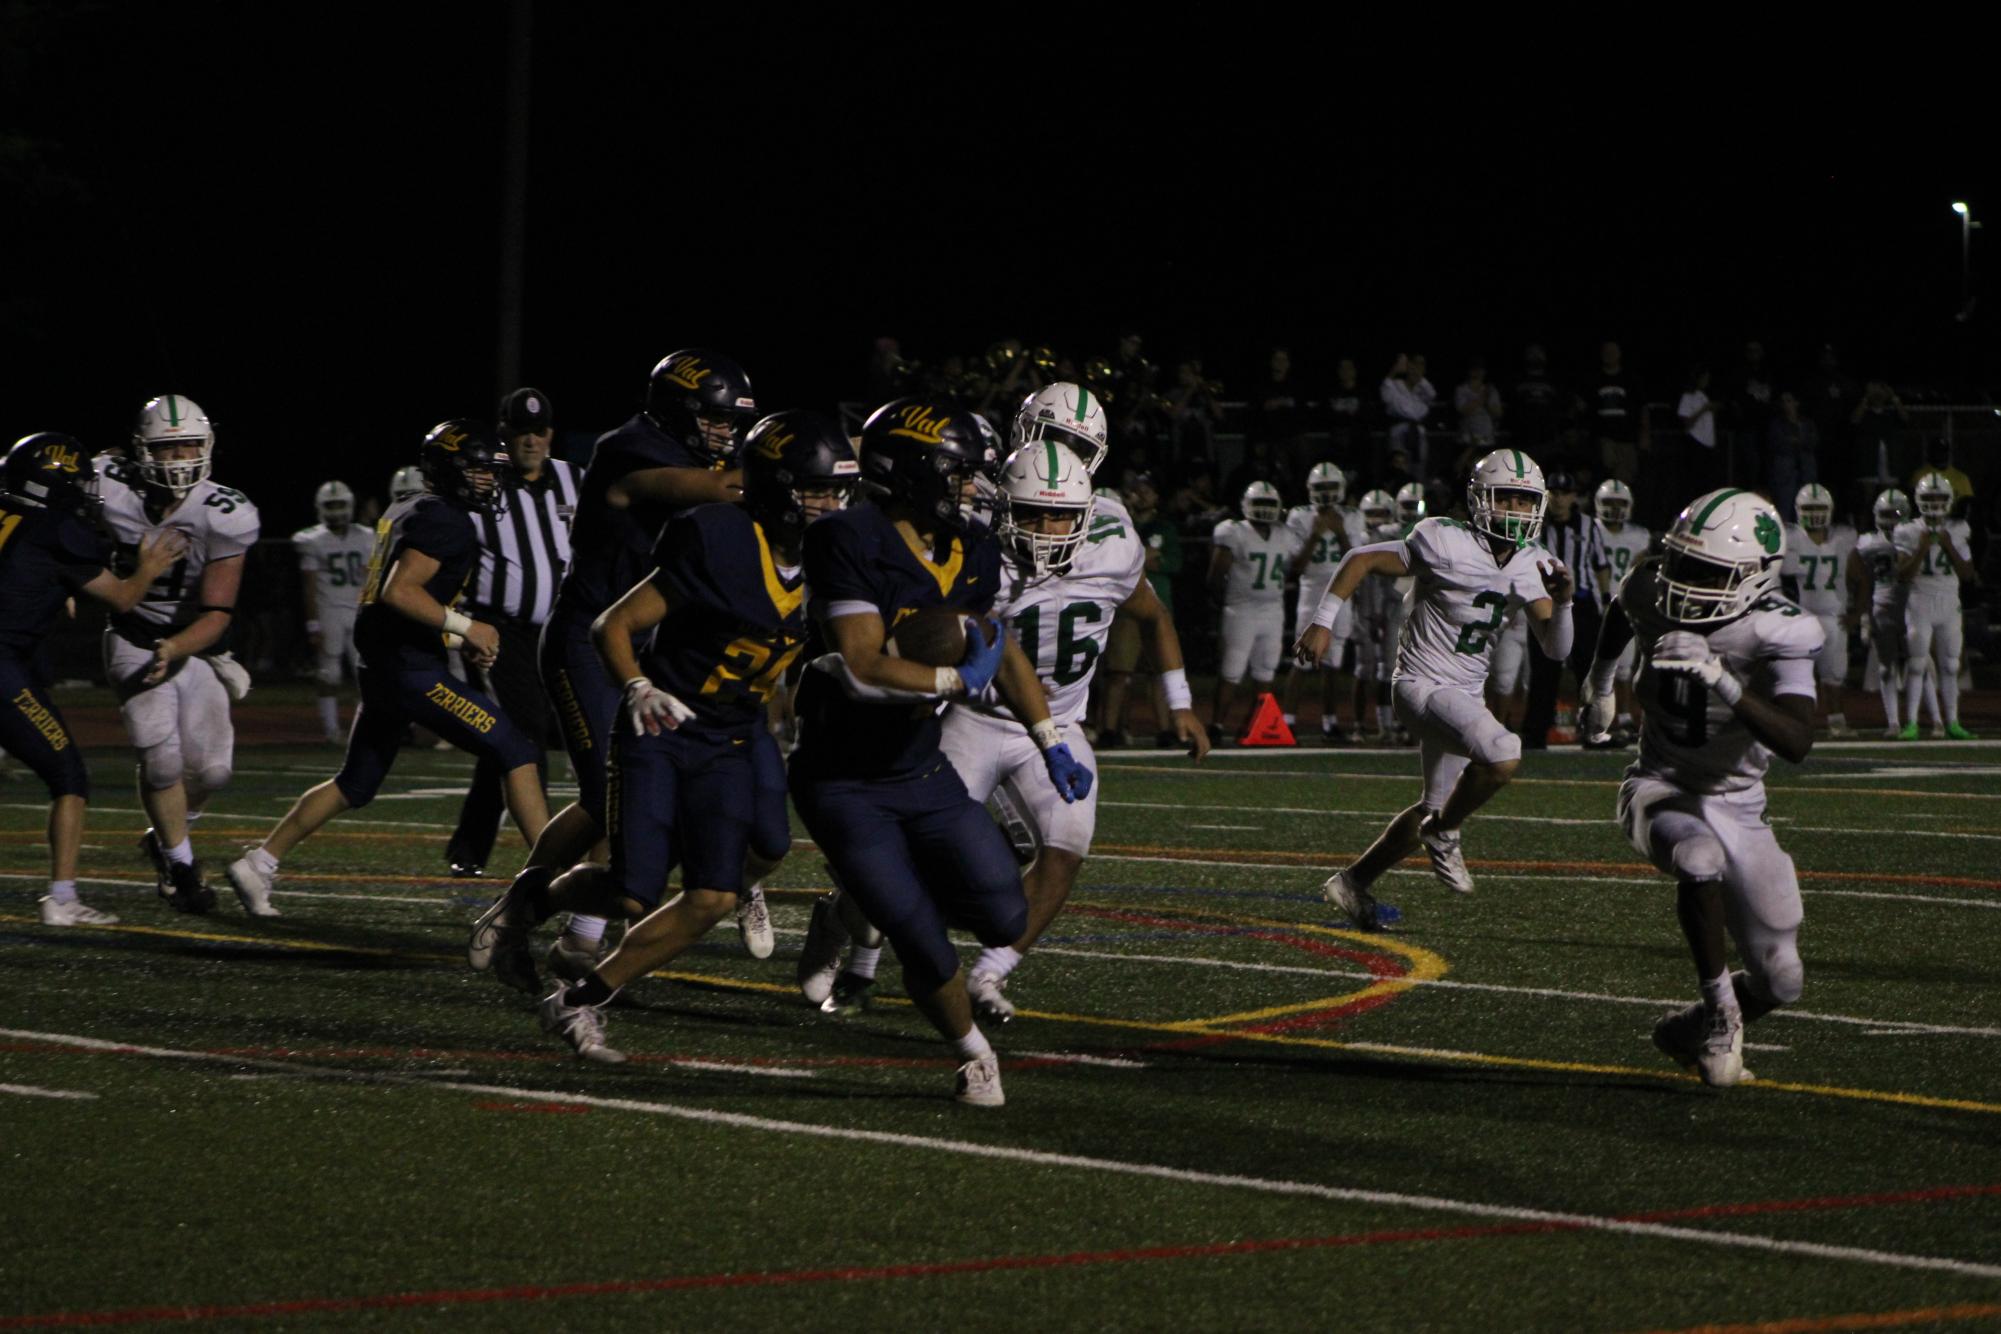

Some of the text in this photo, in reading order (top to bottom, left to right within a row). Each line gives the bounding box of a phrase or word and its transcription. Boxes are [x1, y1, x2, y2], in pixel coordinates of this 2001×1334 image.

[664, 355, 713, 390] Val
[887, 404, 953, 445] Val
[40, 444, 81, 474] Val
[1249, 551, 1285, 591] 74
[1800, 555, 1838, 591] 77
[1920, 550, 1952, 576] 14
[1455, 590, 1507, 655] 2
[1013, 601, 1102, 687] 16
[11, 687, 70, 753] TERRIERS
[423, 676, 497, 735] TERRIERS
